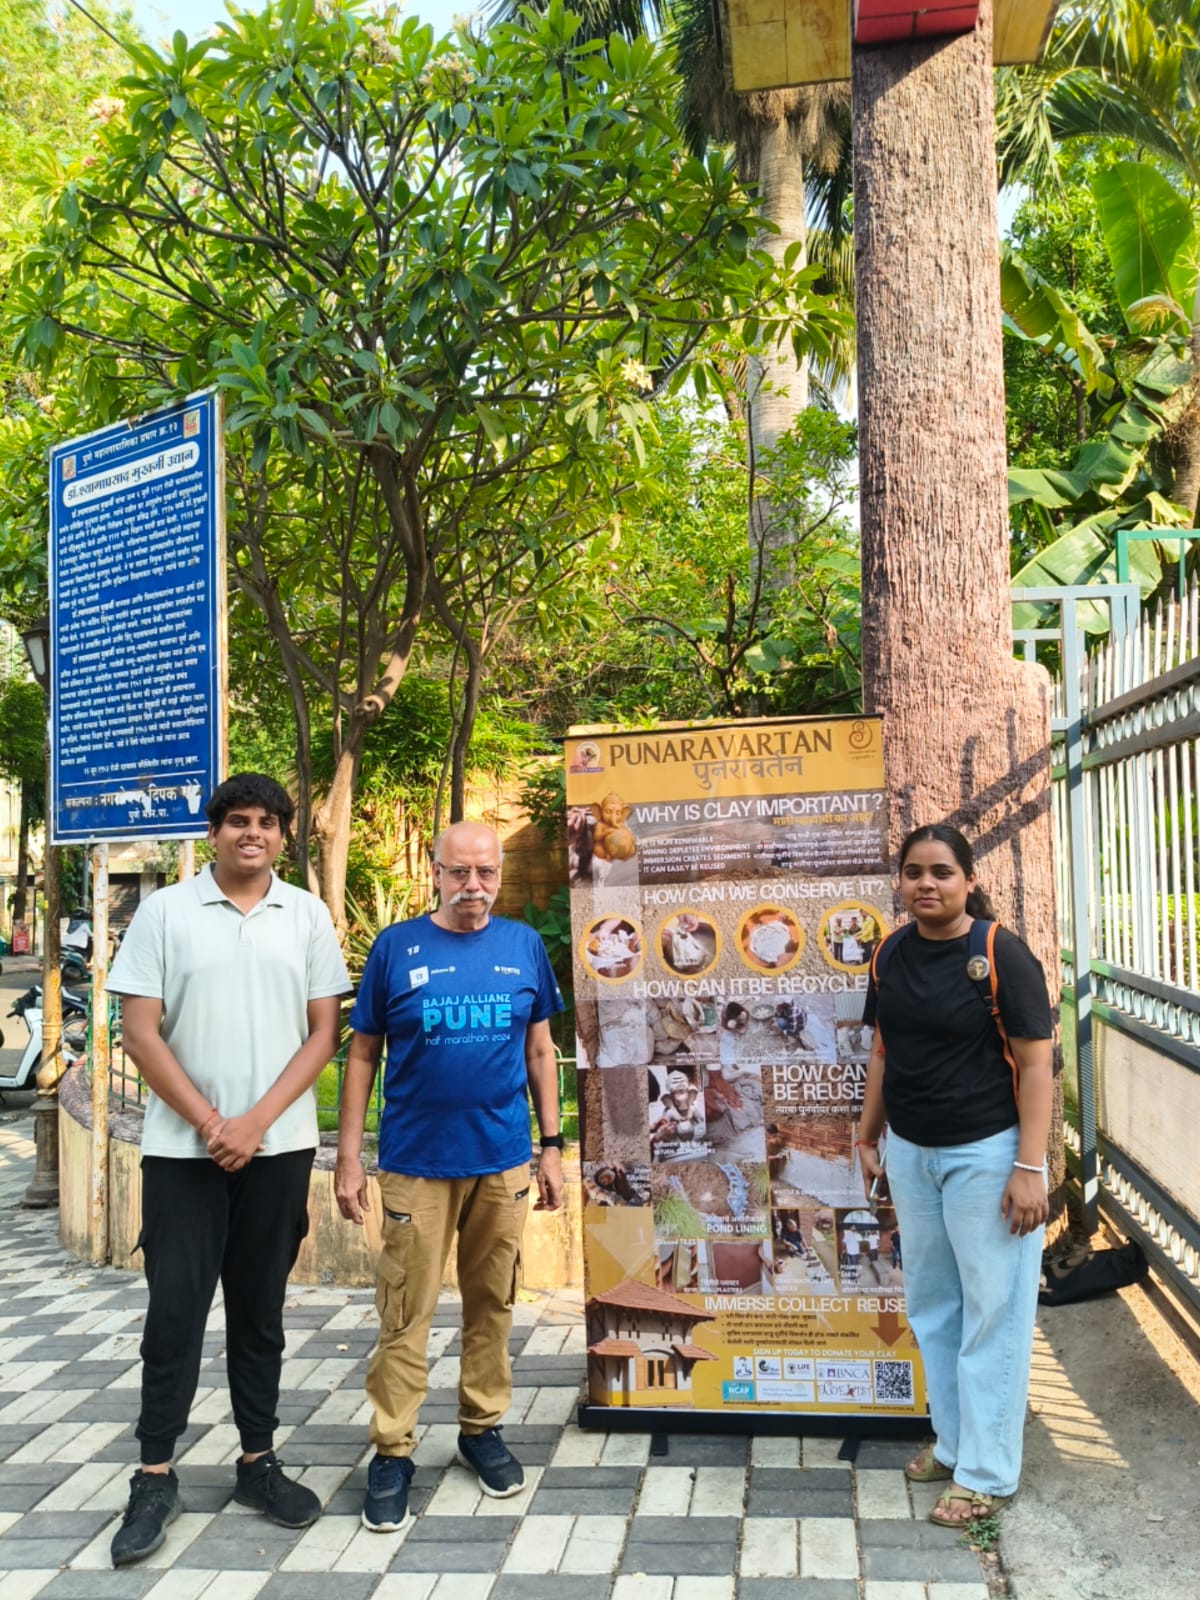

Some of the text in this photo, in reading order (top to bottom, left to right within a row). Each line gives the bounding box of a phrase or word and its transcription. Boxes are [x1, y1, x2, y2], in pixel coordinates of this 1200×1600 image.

[609, 728, 832, 767] PUNARAVARTAN
[693, 750, 804, 789] पुनरावर्तन
[636, 805, 680, 823] WHY
[684, 803, 700, 820] IS
[704, 800, 752, 818] CLAY
[700, 843, 750, 852] ENVIRONMENT
[643, 857, 681, 865] IMMERSION
[683, 855, 711, 863] CREATES
[650, 865, 666, 873] CAN
[667, 864, 690, 872] EASILY
[691, 863, 699, 871] BE
[699, 862, 726, 870] REUSED
[644, 879, 885, 905] HOW CAN WE CONSERVE IT?
[633, 974, 869, 998] HOW CAN IT BE RECYCLE
[423, 993, 511, 1008] BAJAJ ALLIANZ
[423, 1004, 511, 1032] PUNE
[444, 1032, 489, 1045] marathon
[773, 1064, 867, 1081] HOW CAN
[774, 1083, 864, 1100] BE REUSE
[706, 1223, 767, 1233] POND LINING
[705, 1297, 906, 1313] IMMERSE COLLECT REUSE
[783, 1348, 808, 1356] TODAY
